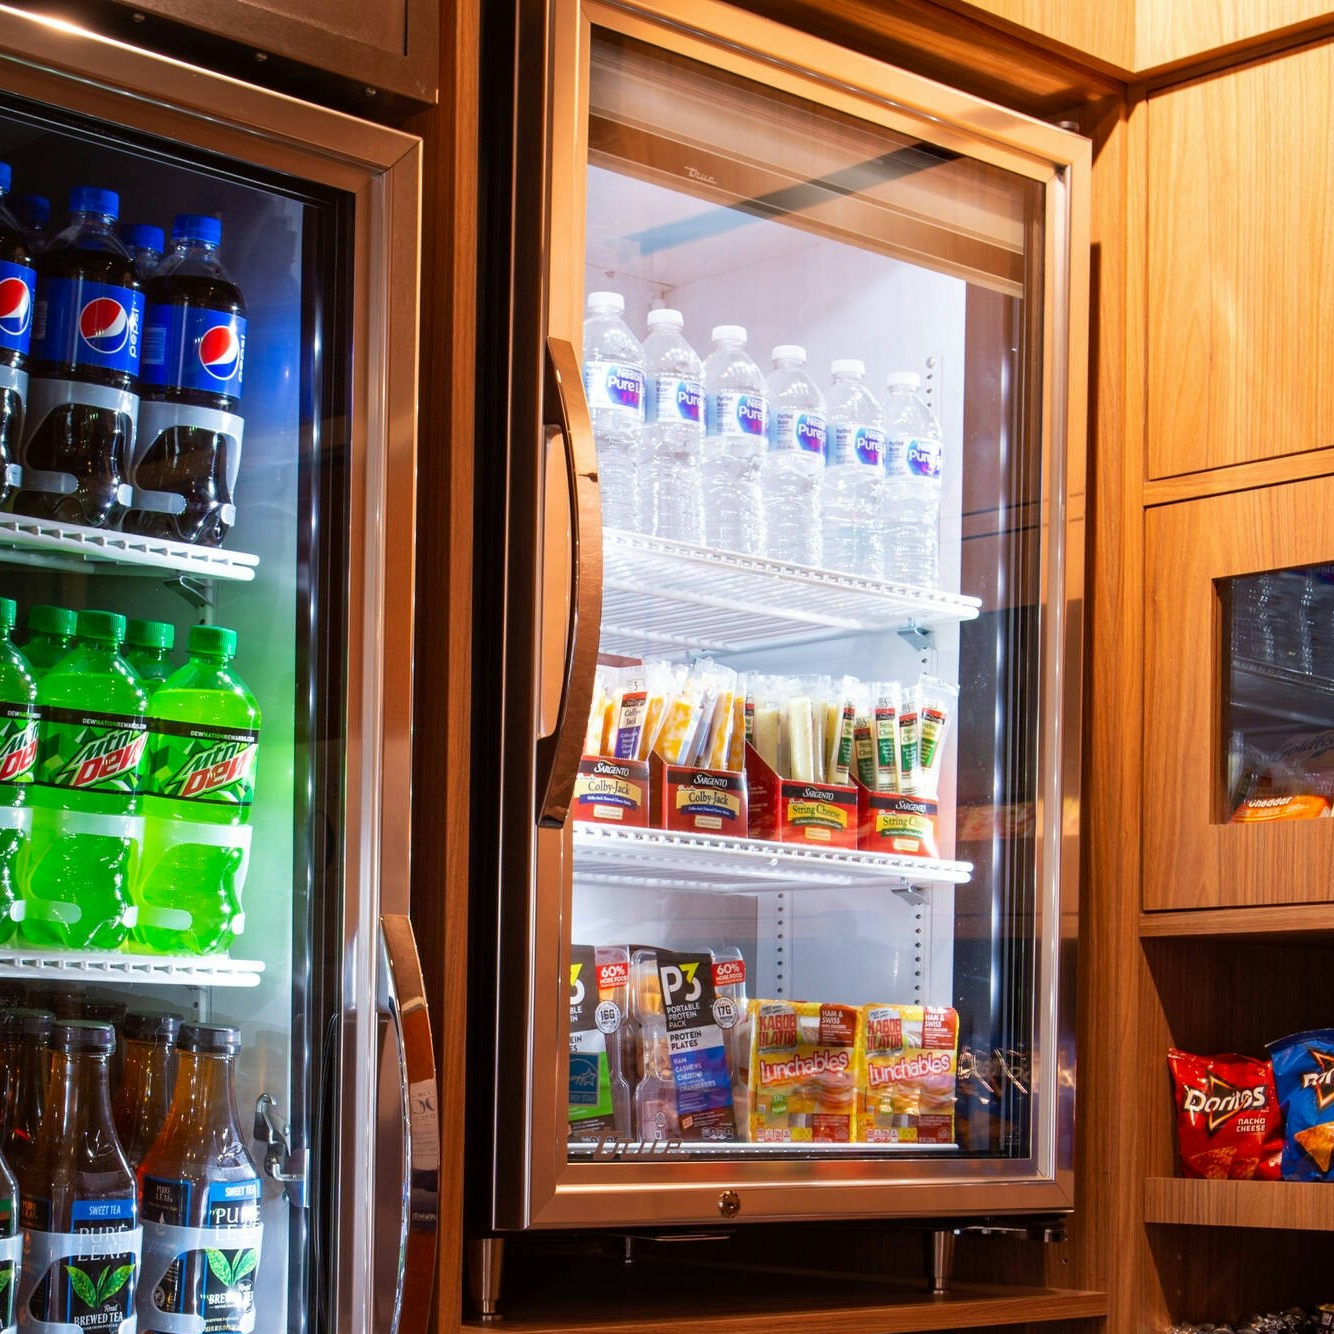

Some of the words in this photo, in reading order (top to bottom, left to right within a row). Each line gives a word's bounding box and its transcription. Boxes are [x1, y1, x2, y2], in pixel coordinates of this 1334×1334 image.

[129, 305, 141, 358] pepsi
[608, 377, 635, 392] Pure
[798, 423, 821, 438] Pure
[78, 729, 129, 764] Mtn
[188, 743, 236, 777] Mtn
[594, 762, 629, 777] SARGENTO
[588, 781, 630, 794] Colby-Jack
[693, 775, 727, 787] SARGENTO
[689, 791, 728, 806] Colby-Jack
[803, 788, 834, 801] SARGENTO
[1249, 795, 1293, 810] Cheddar
[792, 804, 815, 816] String
[816, 807, 841, 820] Cheese
[601, 966, 625, 977] 60%
[717, 964, 739, 974] 60%
[661, 963, 702, 1005] P3
[667, 1003, 700, 1013] PORTABLE
[669, 1012, 697, 1021] PROTEIN
[670, 1031, 701, 1041] PROTEIN
[672, 1041, 698, 1050] PLATES
[761, 1051, 849, 1085] Lunchables
[869, 1054, 950, 1085] Lunchables
[1185, 1086, 1265, 1112] Doritos
[89, 1205, 109, 1215] SWEET
[110, 1205, 121, 1215] TEA
[74, 1313, 108, 1326] BREWED
[110, 1311, 123, 1322] TEA
